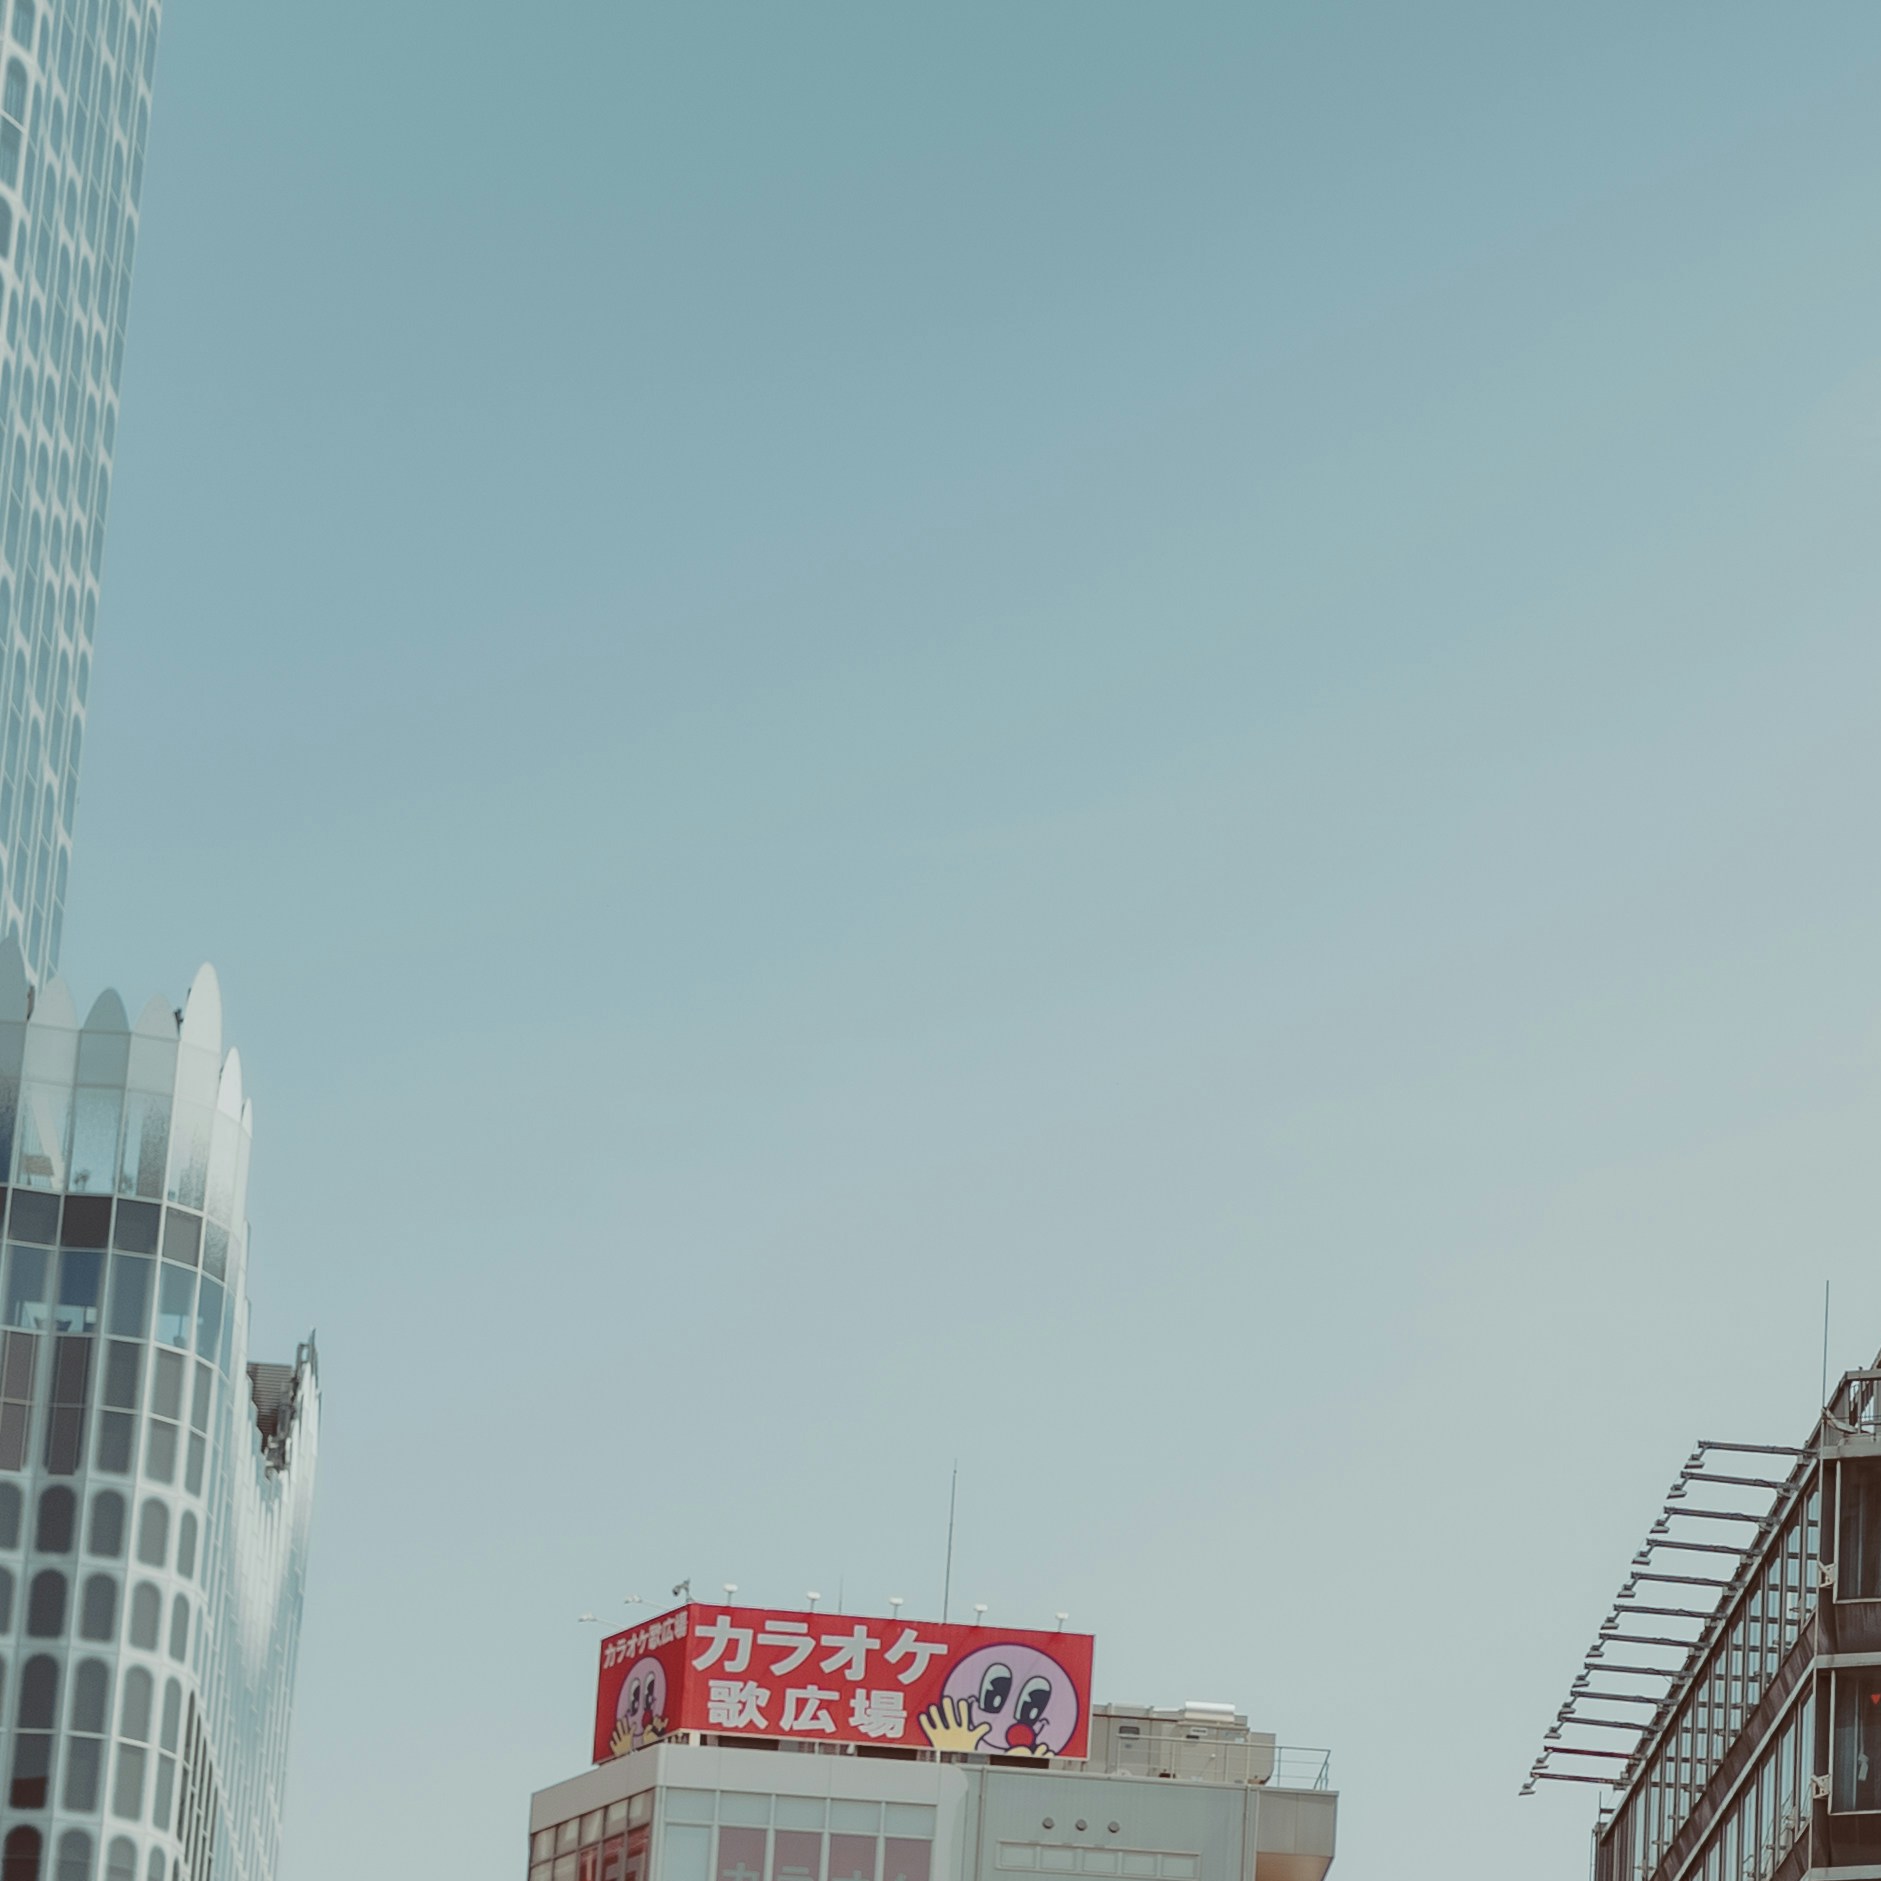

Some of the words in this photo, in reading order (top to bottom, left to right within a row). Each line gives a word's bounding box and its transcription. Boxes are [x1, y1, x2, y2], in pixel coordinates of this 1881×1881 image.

[603, 1610, 690, 1670] カラオケ歌広場
[692, 1615, 949, 1686] カラオケ
[707, 1678, 909, 1740] 歌広場
